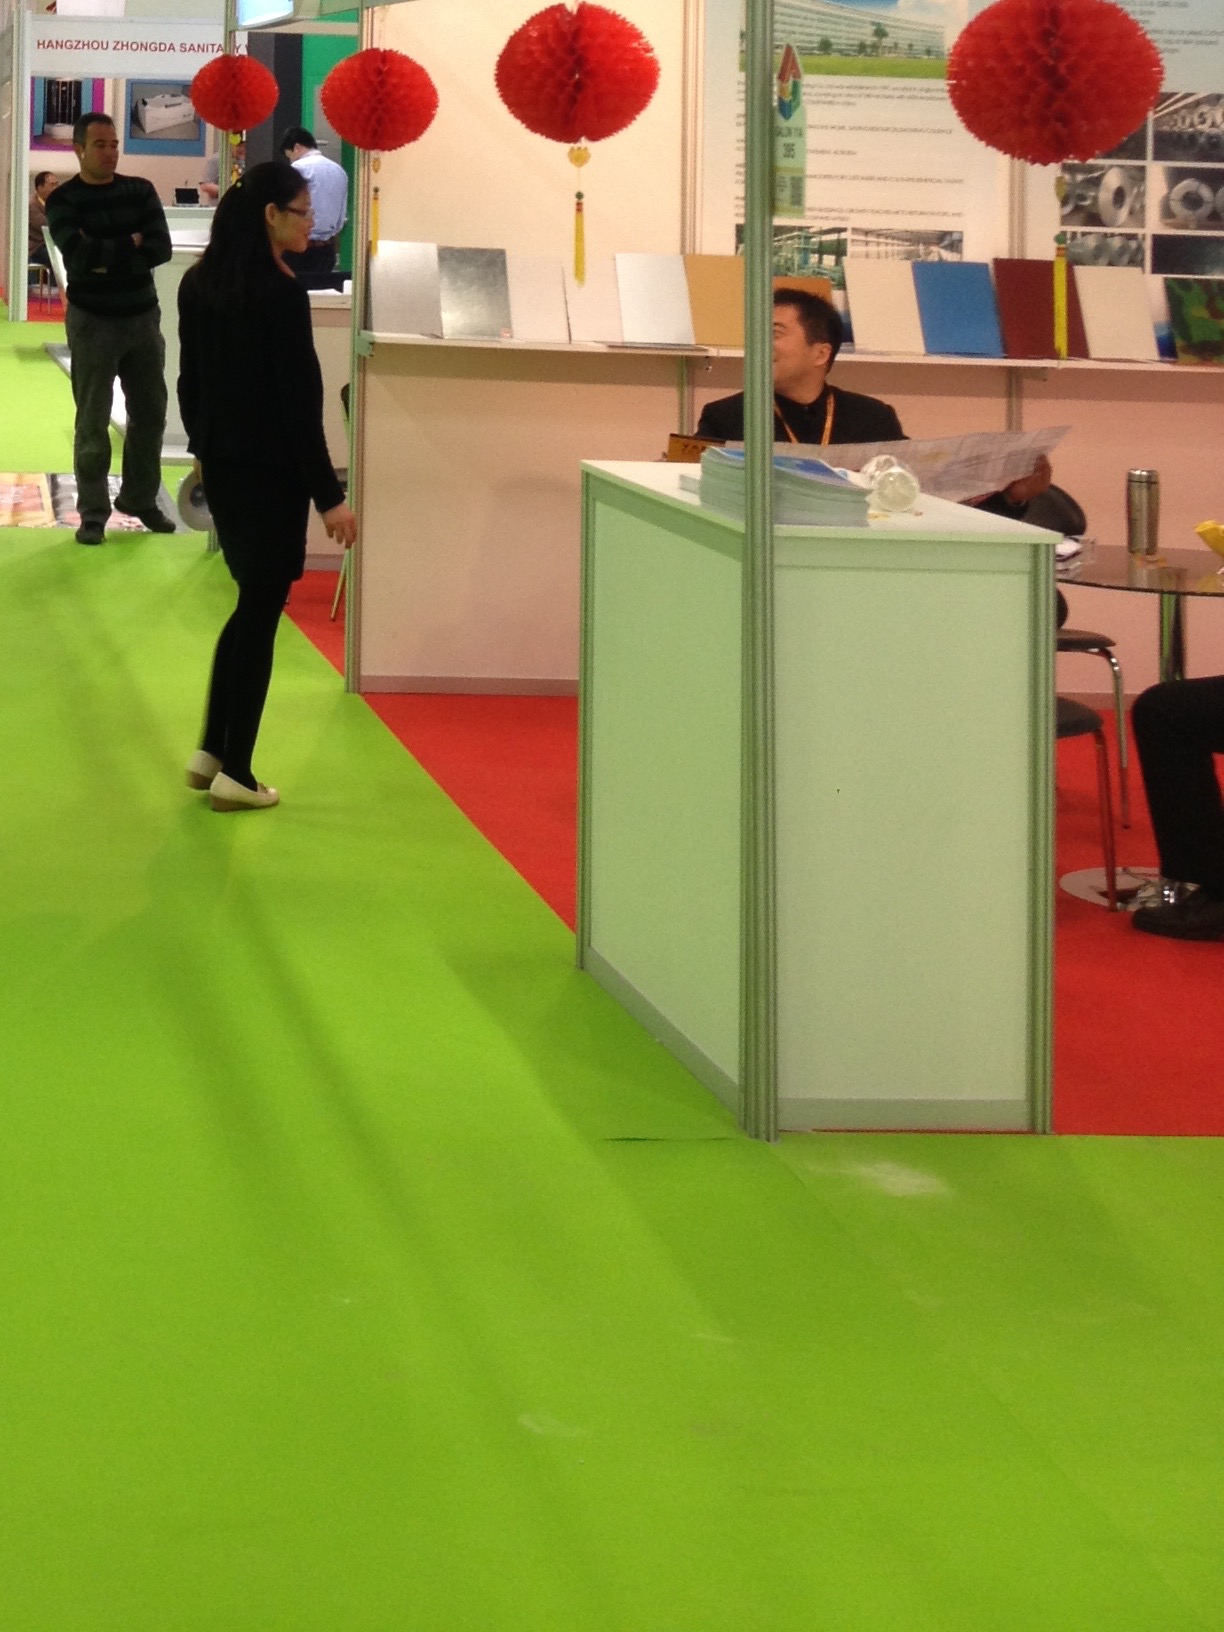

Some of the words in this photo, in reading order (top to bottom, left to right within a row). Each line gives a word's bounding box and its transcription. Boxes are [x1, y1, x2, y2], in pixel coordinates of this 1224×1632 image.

[36, 39, 109, 51] HANGZHOU
[112, 40, 176, 52] ZHONGDA
[179, 43, 240, 54] SANITAY
